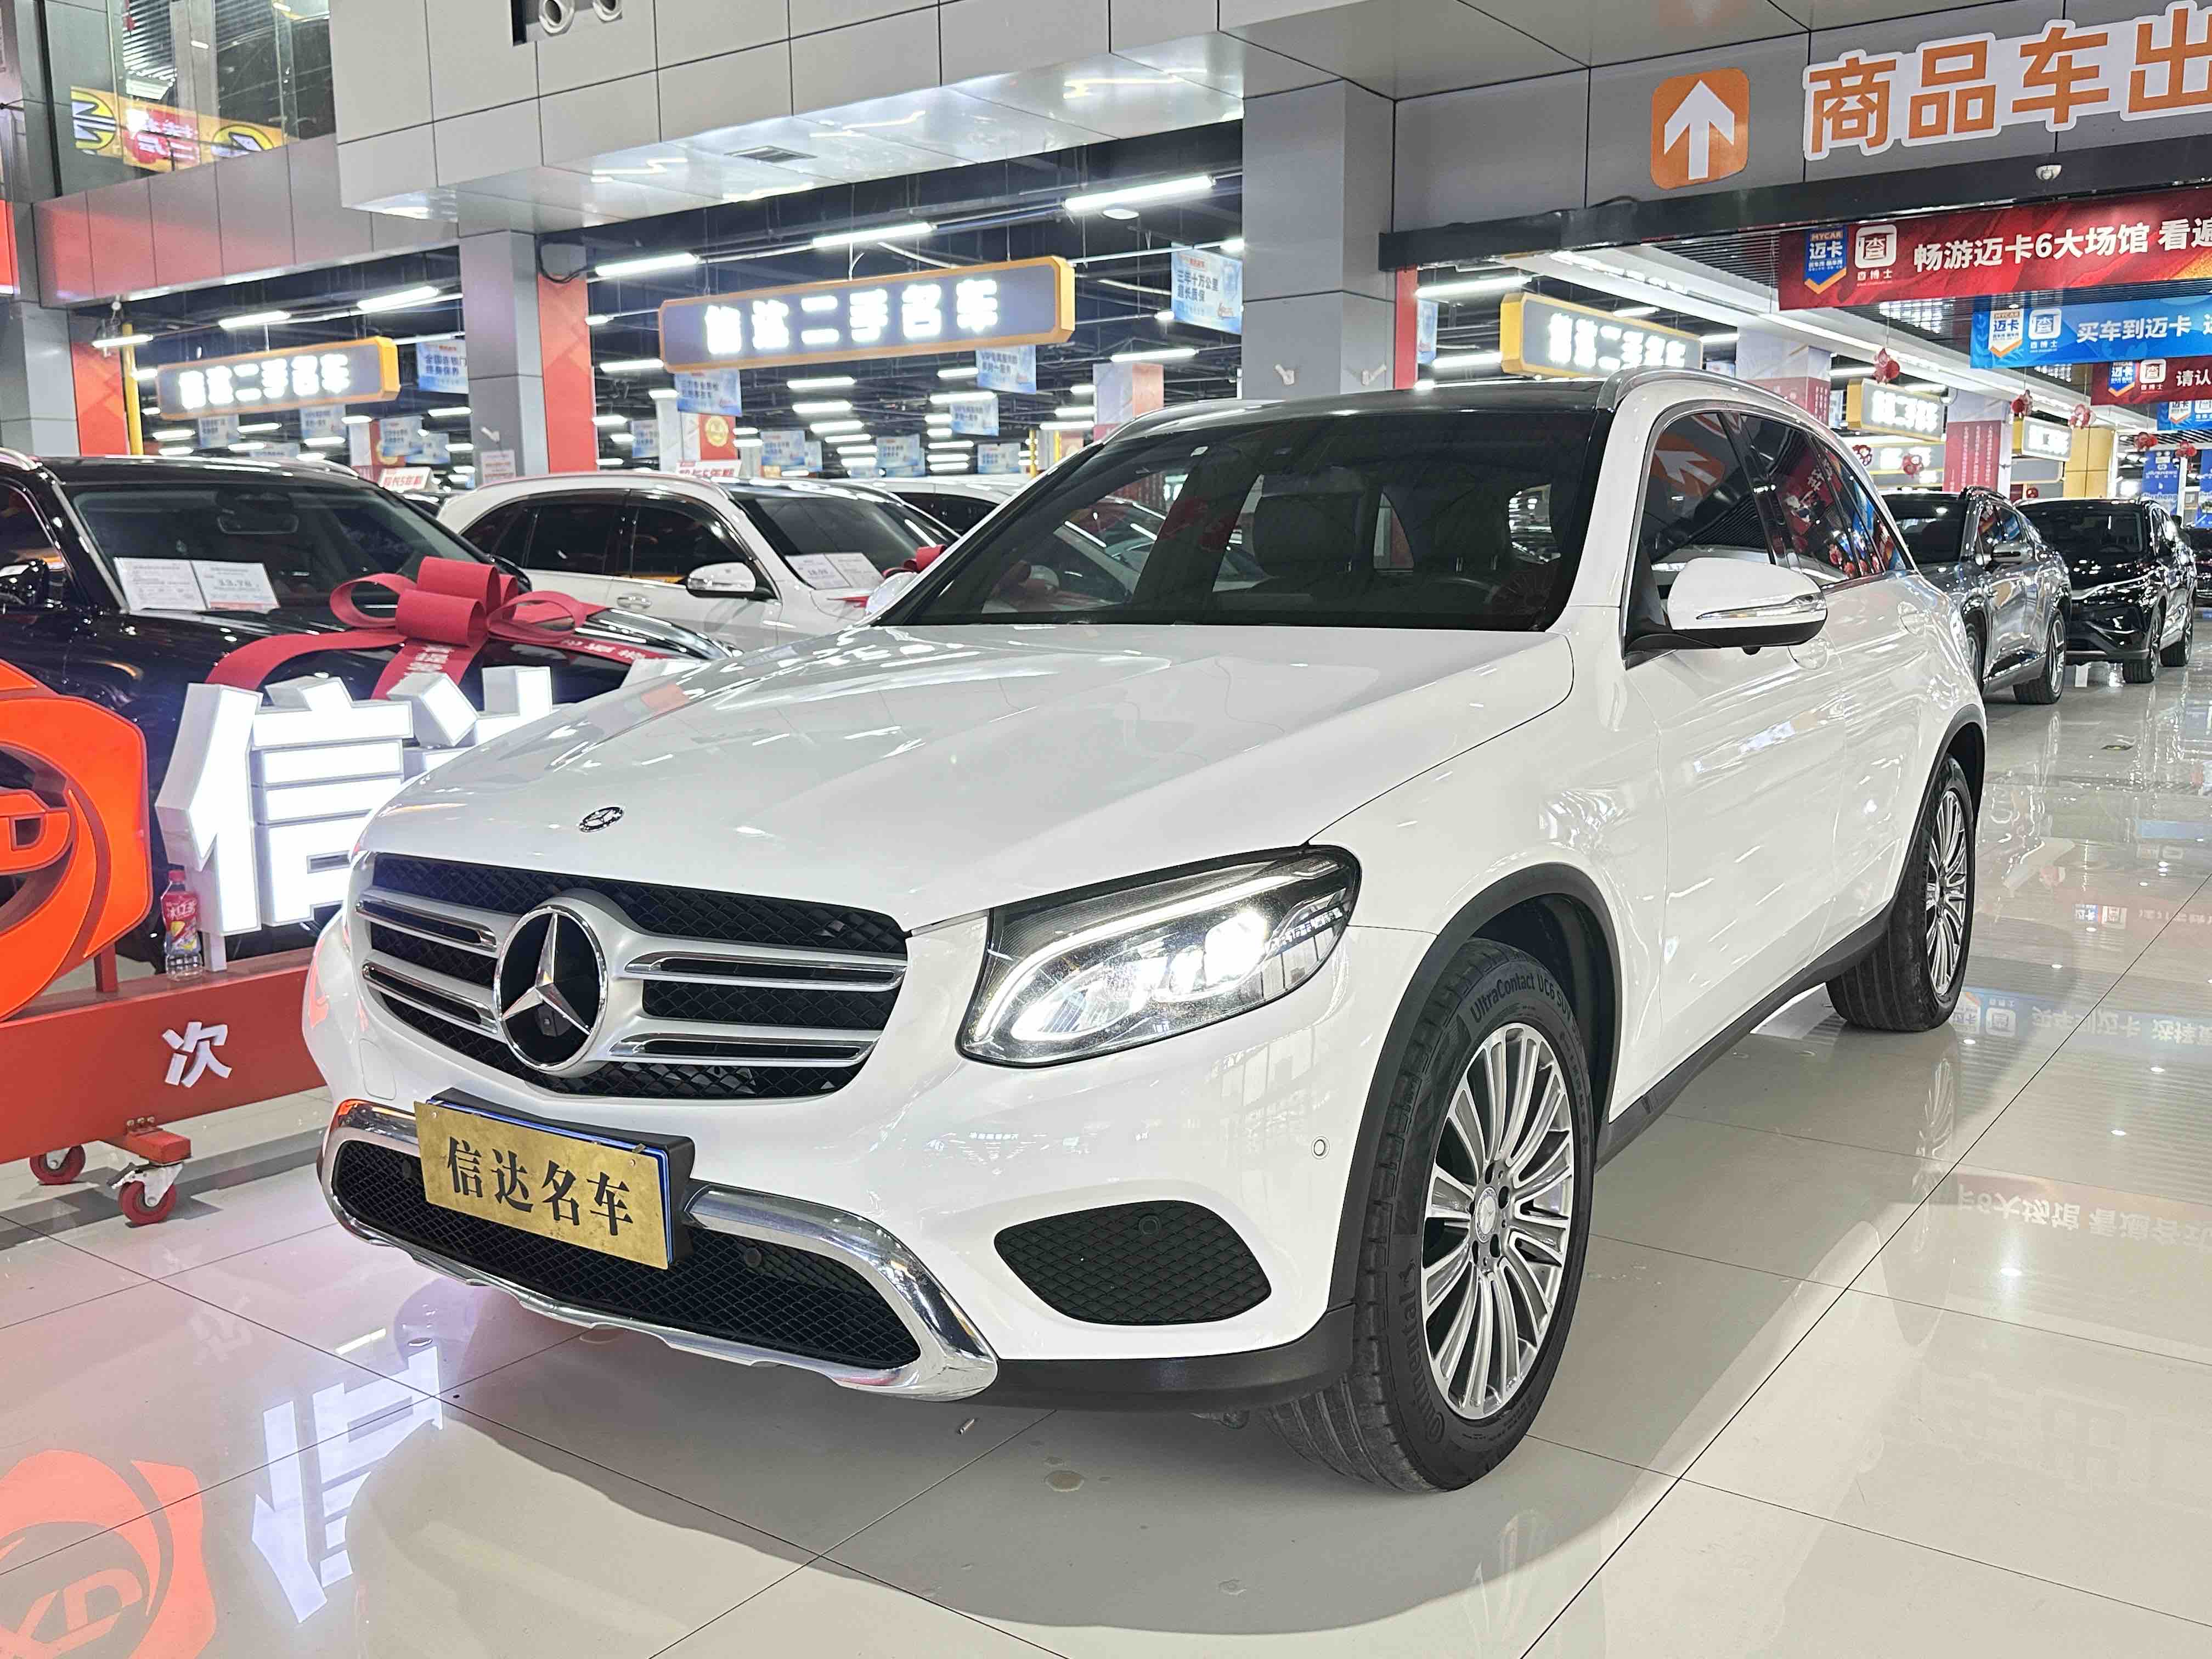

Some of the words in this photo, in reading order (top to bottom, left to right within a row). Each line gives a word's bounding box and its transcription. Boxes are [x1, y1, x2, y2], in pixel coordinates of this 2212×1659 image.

[1807, 5, 2212, 156] 商品车出
[1809, 240, 1843, 260] 迈卡
[1811, 230, 1843, 241] MYCAR
[1914, 221, 2150, 273] 畅游迈卡6大场馆
[1993, 319, 2019, 332] 迈卡
[2076, 314, 2192, 343] 买车到迈卡
[2175, 369, 2212, 387] 请认
[1470, 972, 1536, 1023] UltraContact
[1537, 973, 1555, 1000] UC6
[161, 1020, 232, 1088] 次
[446, 1136, 634, 1237] 信达名车
